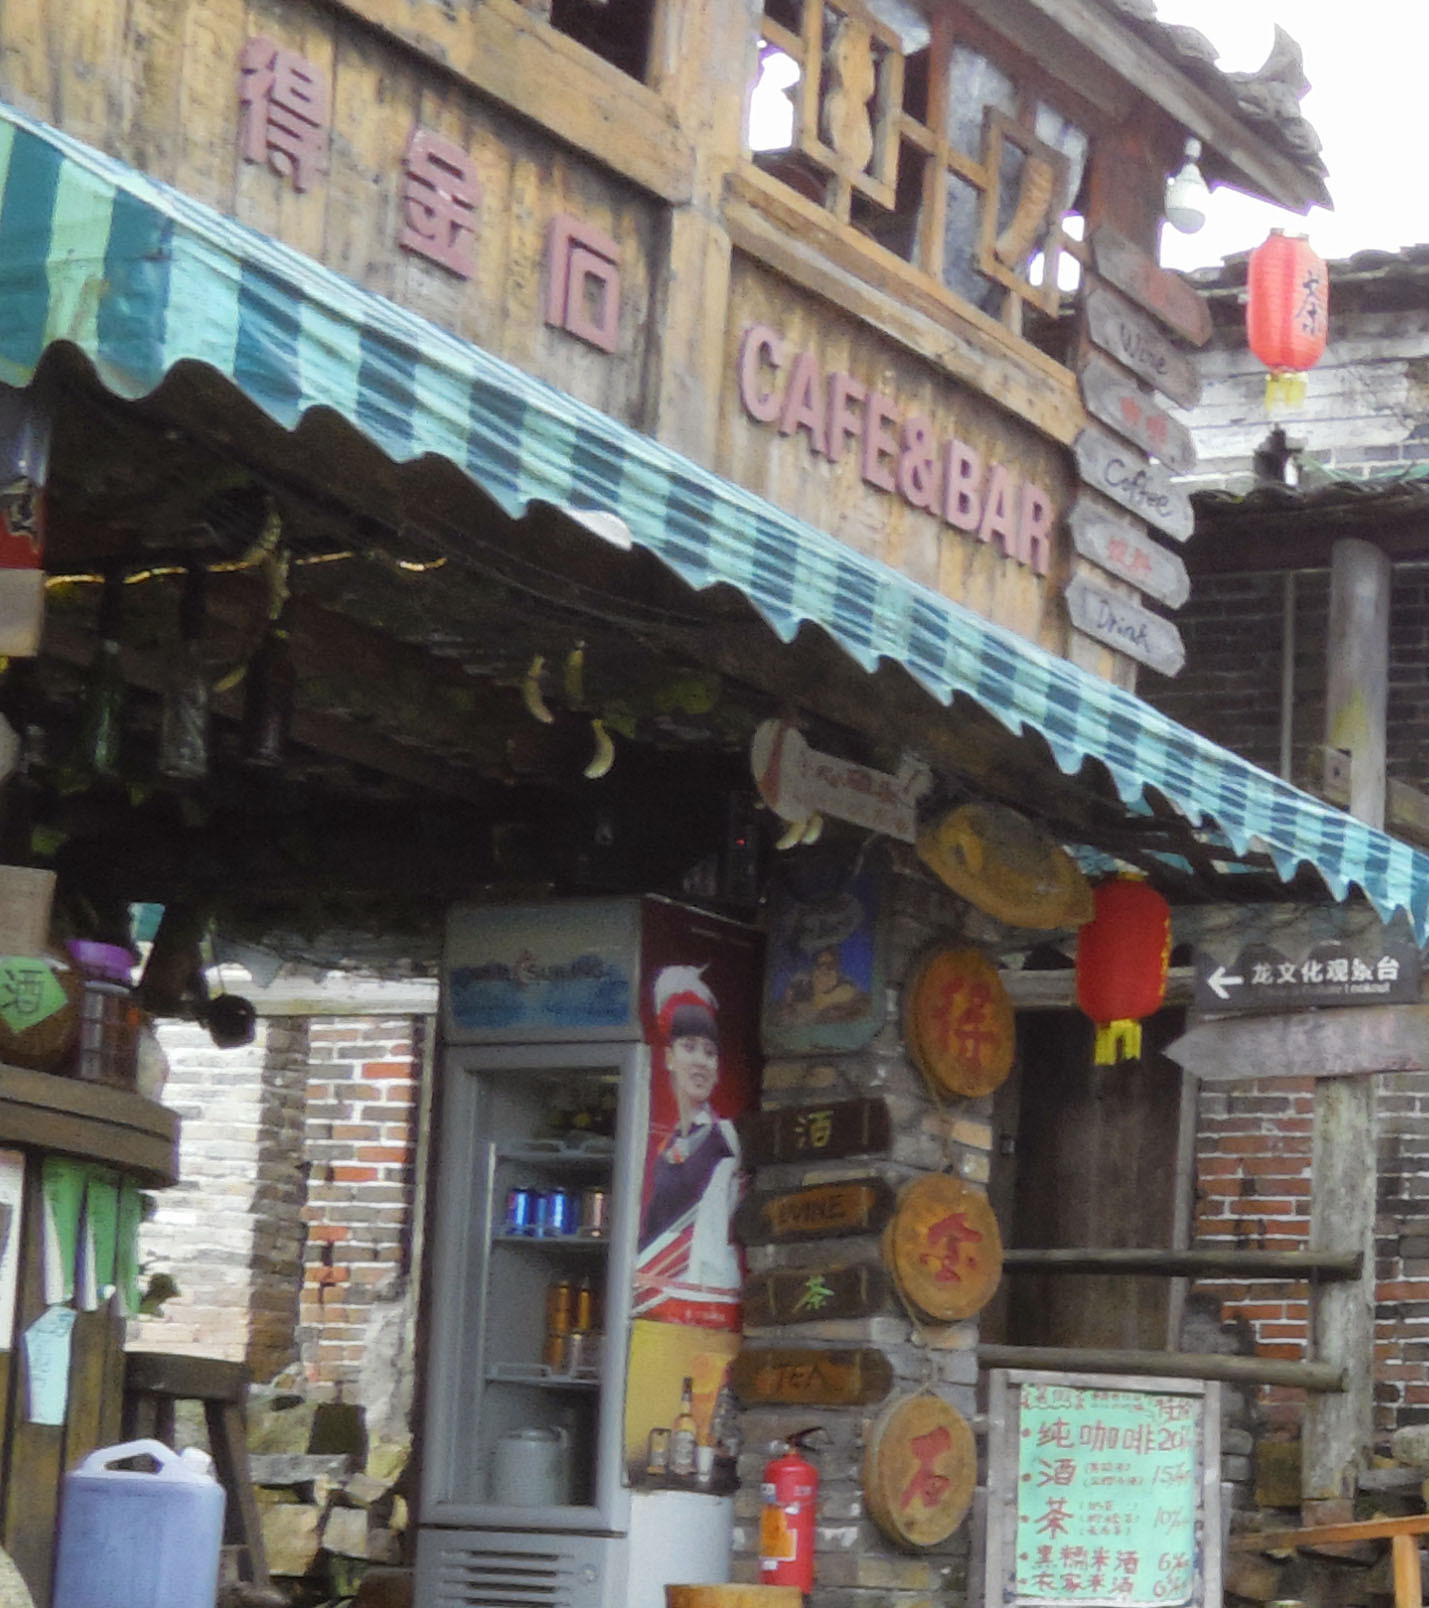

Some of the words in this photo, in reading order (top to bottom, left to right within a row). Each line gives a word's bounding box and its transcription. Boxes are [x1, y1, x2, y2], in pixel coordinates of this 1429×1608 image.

[738, 325, 1053, 575] CAFE&BAR
[1104, 458, 1173, 518] Coffee
[1097, 599, 1152, 654] Drink
[794, 1111, 834, 1148] 酒
[1036, 1458, 1077, 1488] 酒
[1035, 1497, 1074, 1539] 茶
